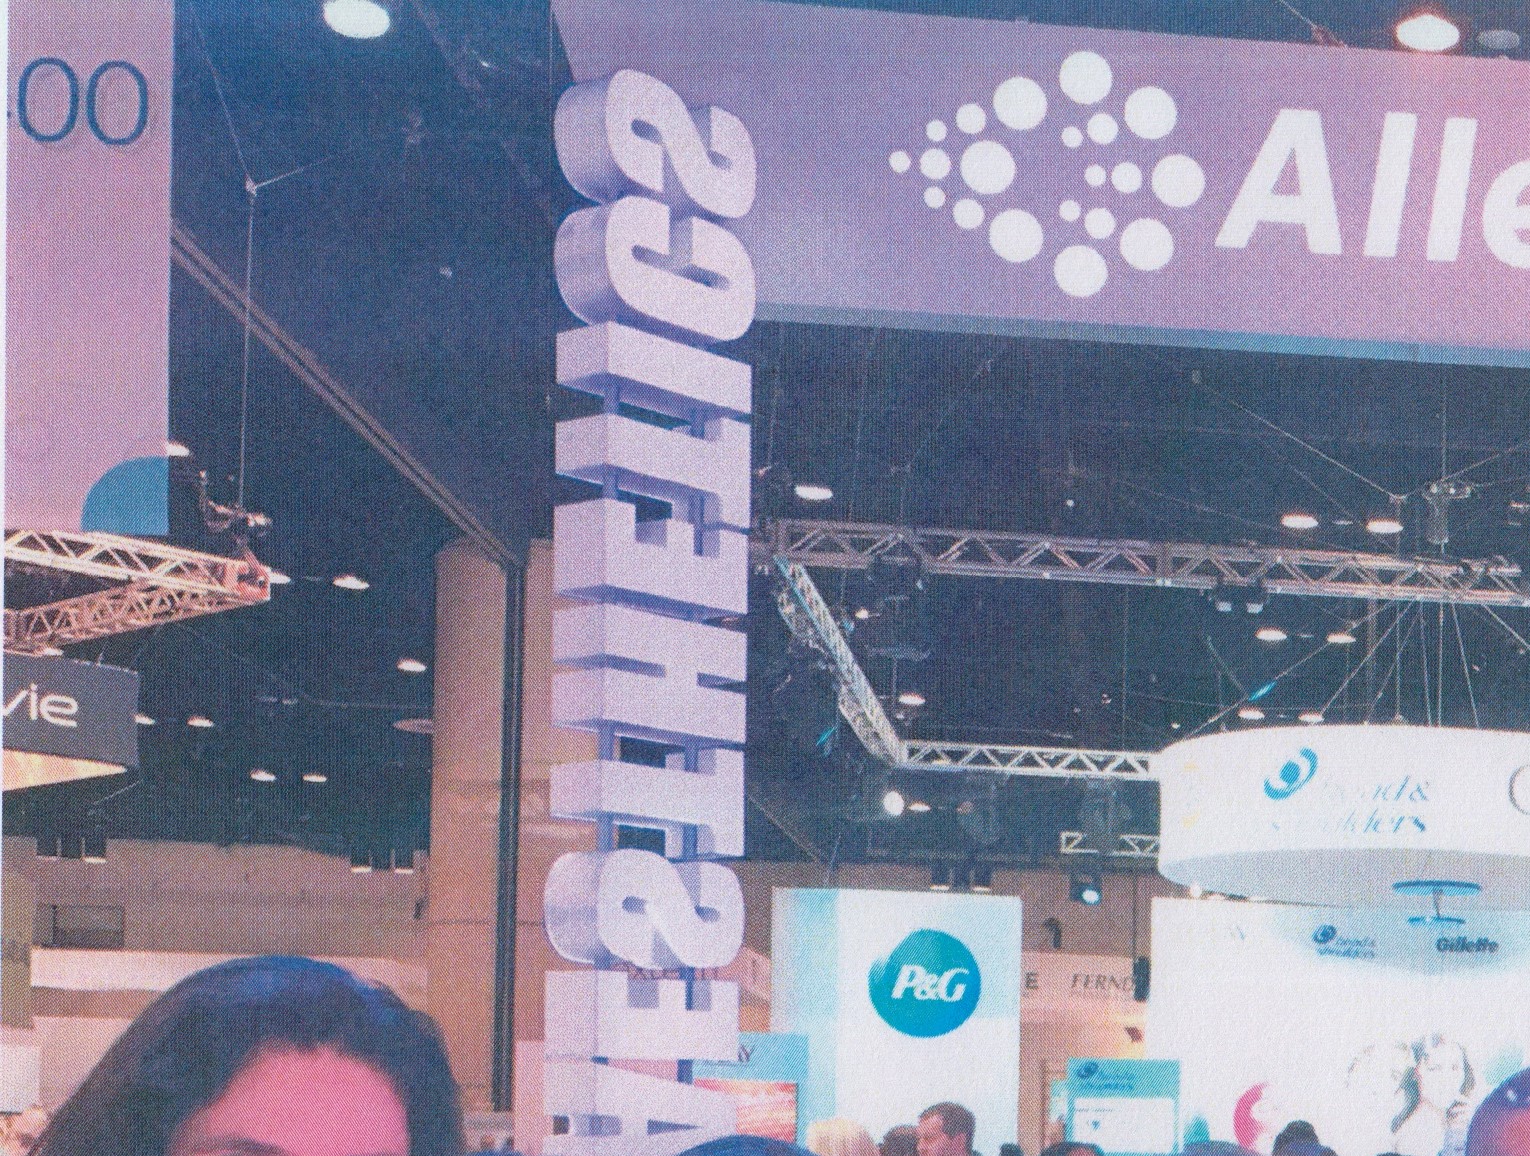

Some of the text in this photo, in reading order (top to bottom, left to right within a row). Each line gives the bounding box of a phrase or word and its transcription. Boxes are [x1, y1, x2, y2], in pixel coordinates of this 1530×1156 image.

[8, 57, 149, 145] 00
[1436, 937, 1499, 953] Gillette
[891, 964, 970, 1002] P&G
